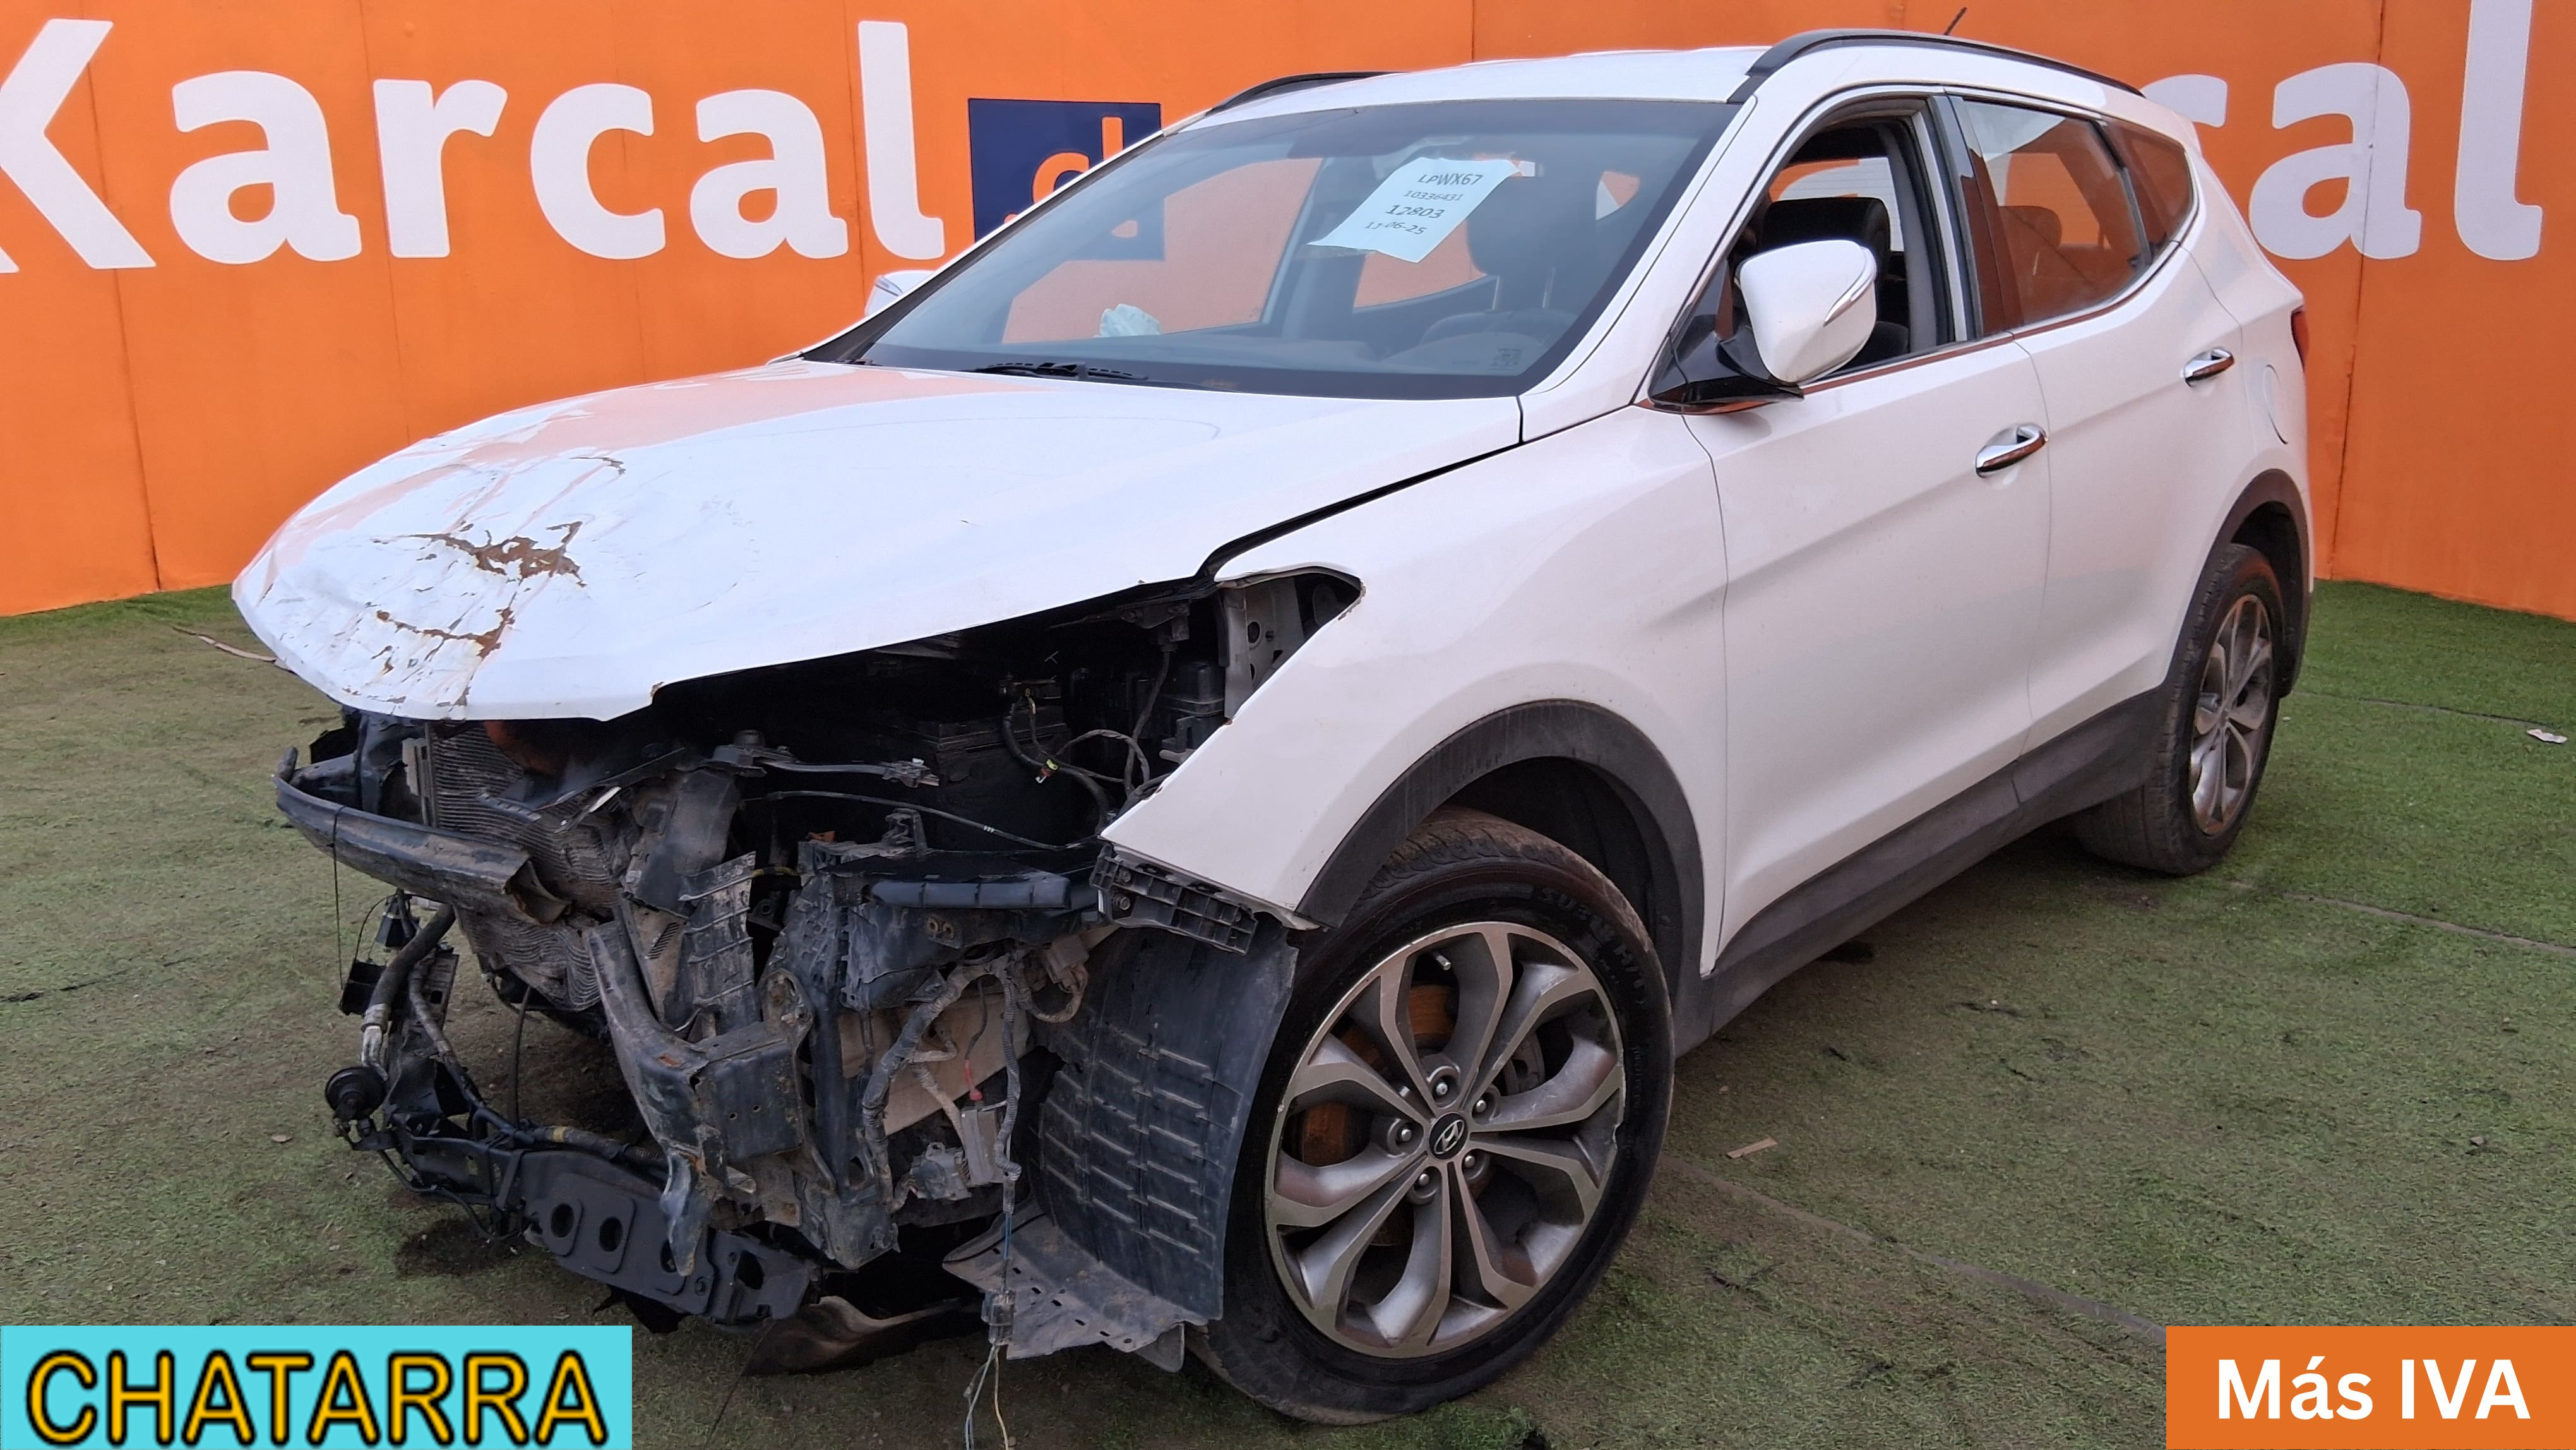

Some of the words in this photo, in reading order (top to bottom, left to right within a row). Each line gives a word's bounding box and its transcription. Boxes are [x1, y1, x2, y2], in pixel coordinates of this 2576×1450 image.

[1417, 173, 1484, 186] LPWX67
[1403, 190, 1464, 201] 10336431
[1385, 205, 1445, 219] 12803
